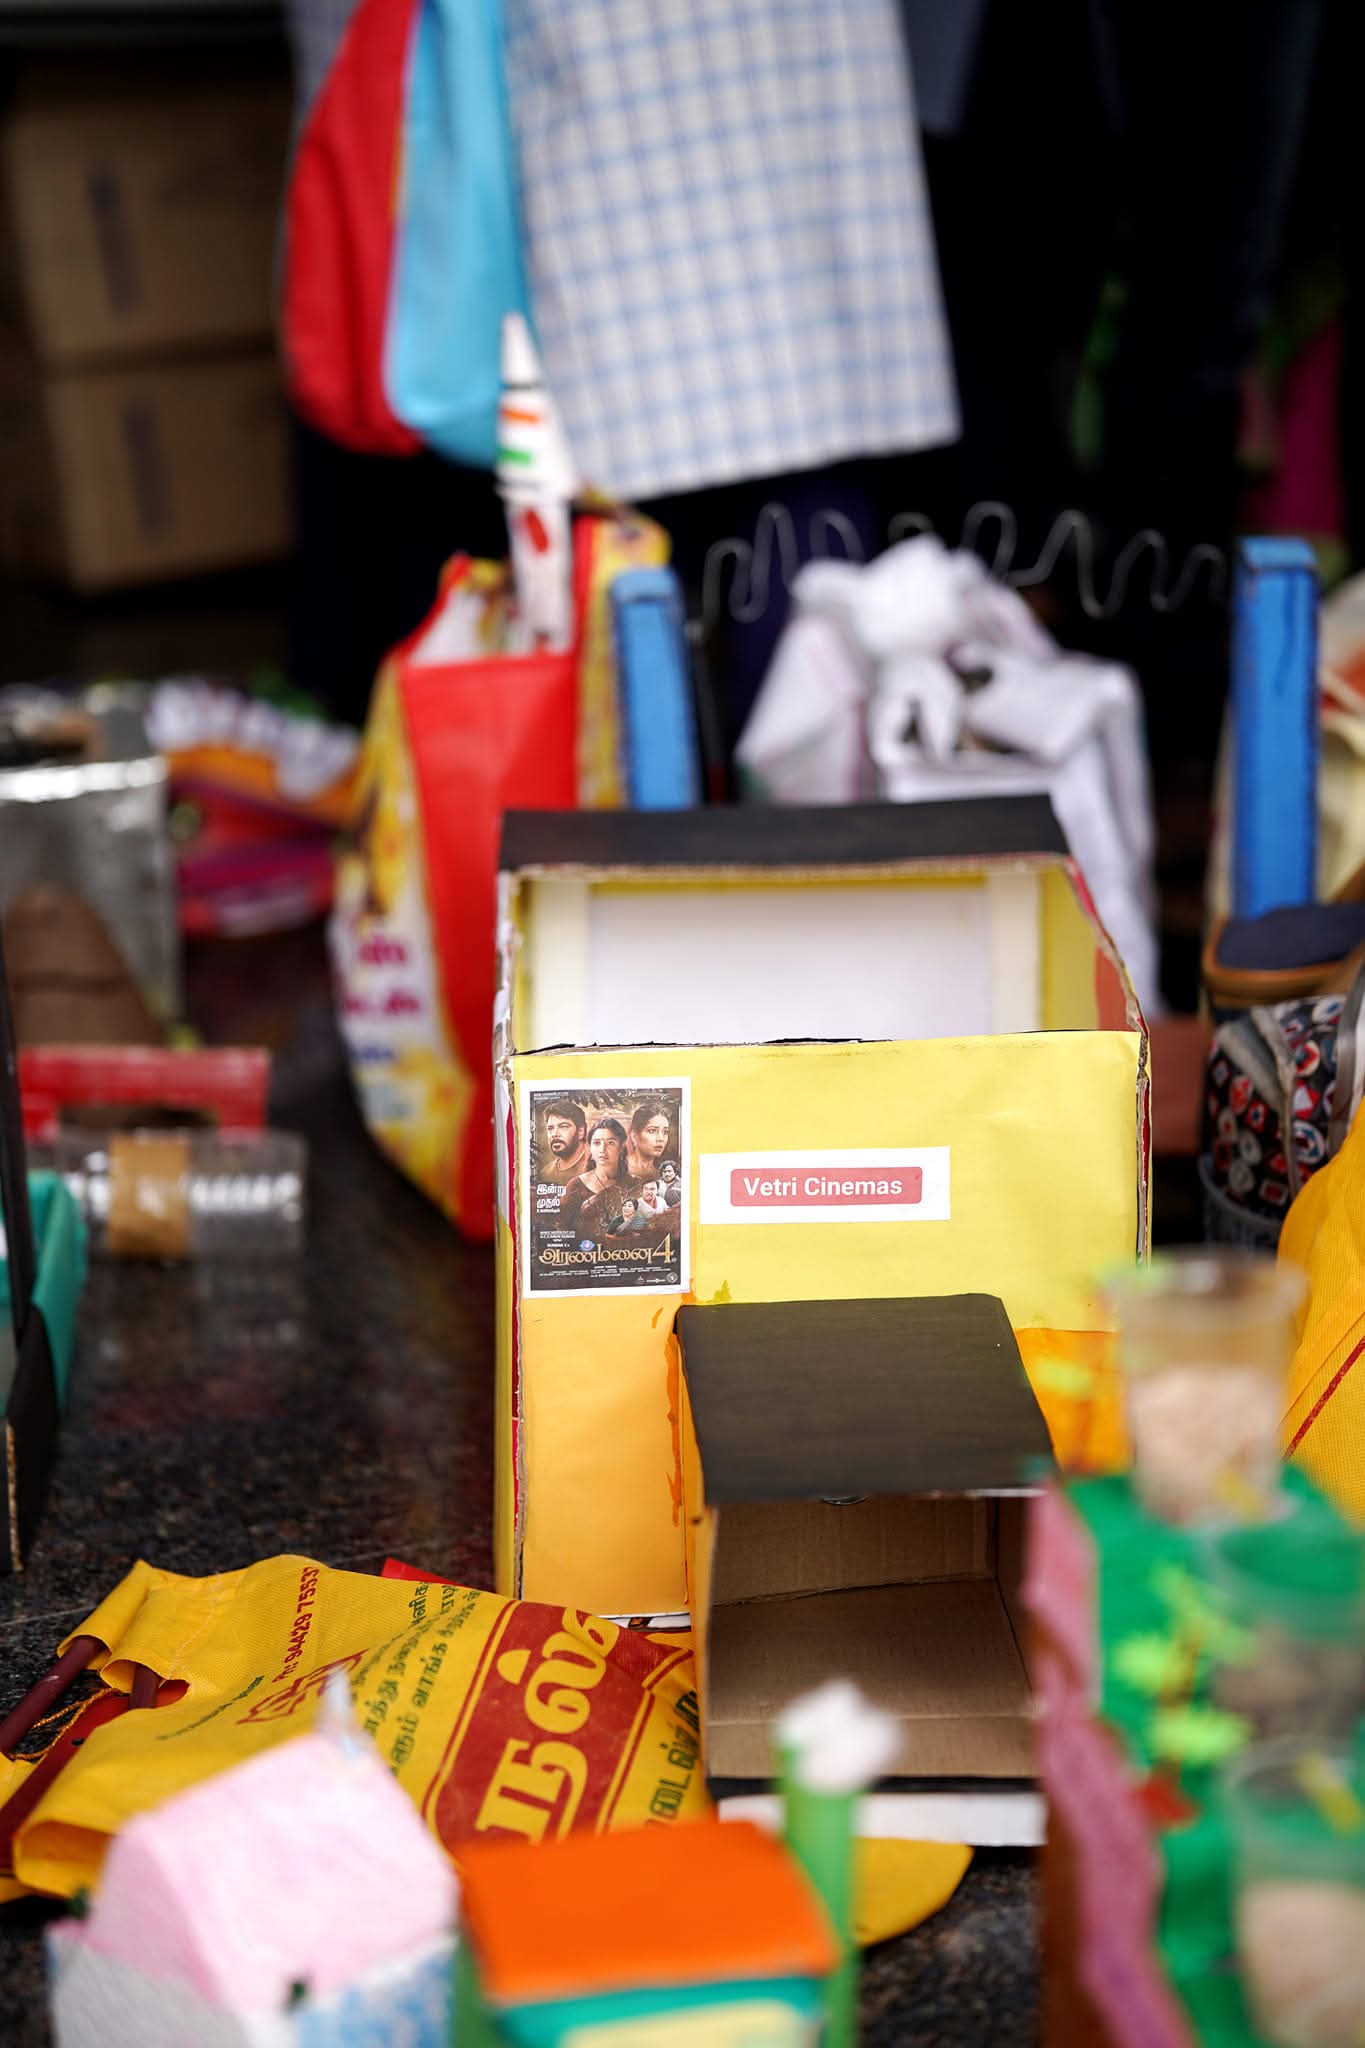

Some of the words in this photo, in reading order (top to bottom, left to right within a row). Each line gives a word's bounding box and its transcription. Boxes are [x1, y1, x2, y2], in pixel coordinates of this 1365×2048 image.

[744, 1176, 797, 1197] Vetri
[804, 1174, 903, 1197] Cinemas
[283, 1611, 312, 1661] 94429
